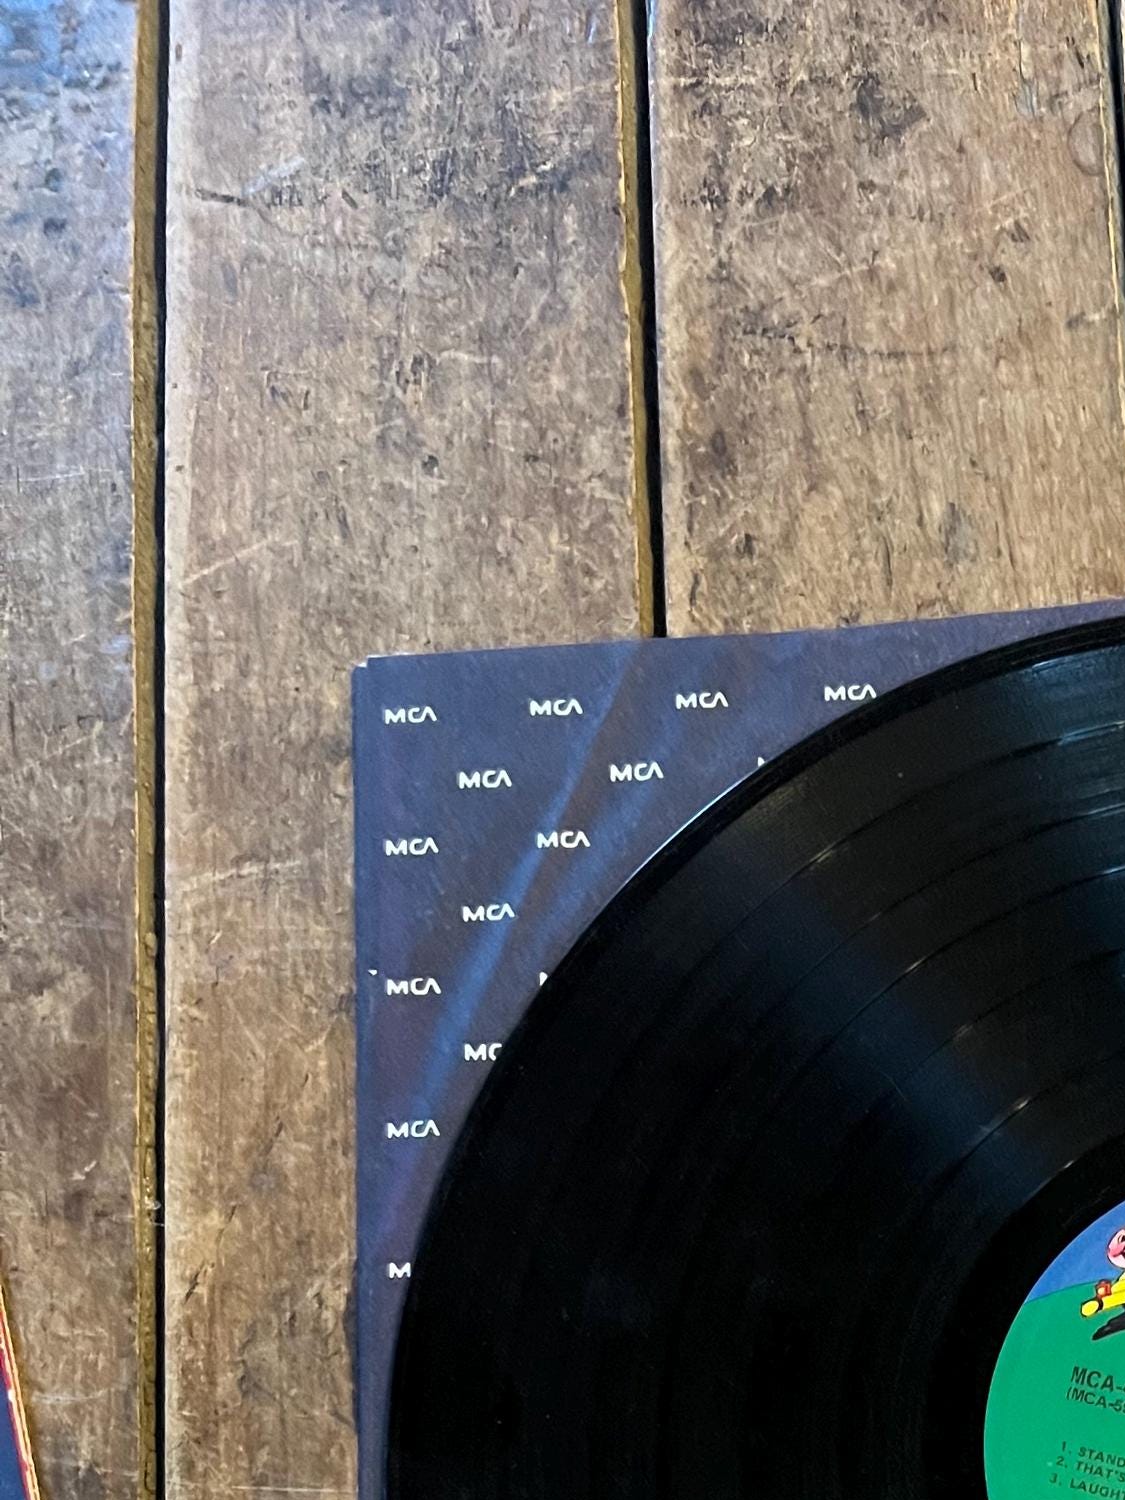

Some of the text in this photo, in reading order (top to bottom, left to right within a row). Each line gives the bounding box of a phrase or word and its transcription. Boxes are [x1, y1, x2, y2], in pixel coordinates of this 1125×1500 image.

[676, 692, 728, 709] MCA
[824, 684, 876, 701] MCA
[383, 706, 437, 724] MCA
[530, 698, 583, 716] MCA
[458, 770, 512, 789] MCA
[609, 761, 664, 782] MCA
[384, 837, 439, 856] MCA
[537, 831, 590, 848] MCA
[462, 903, 515, 922] MCA
[385, 978, 441, 995] MCA
[464, 1043, 503, 1061] MC
[386, 1120, 440, 1138] MCA
